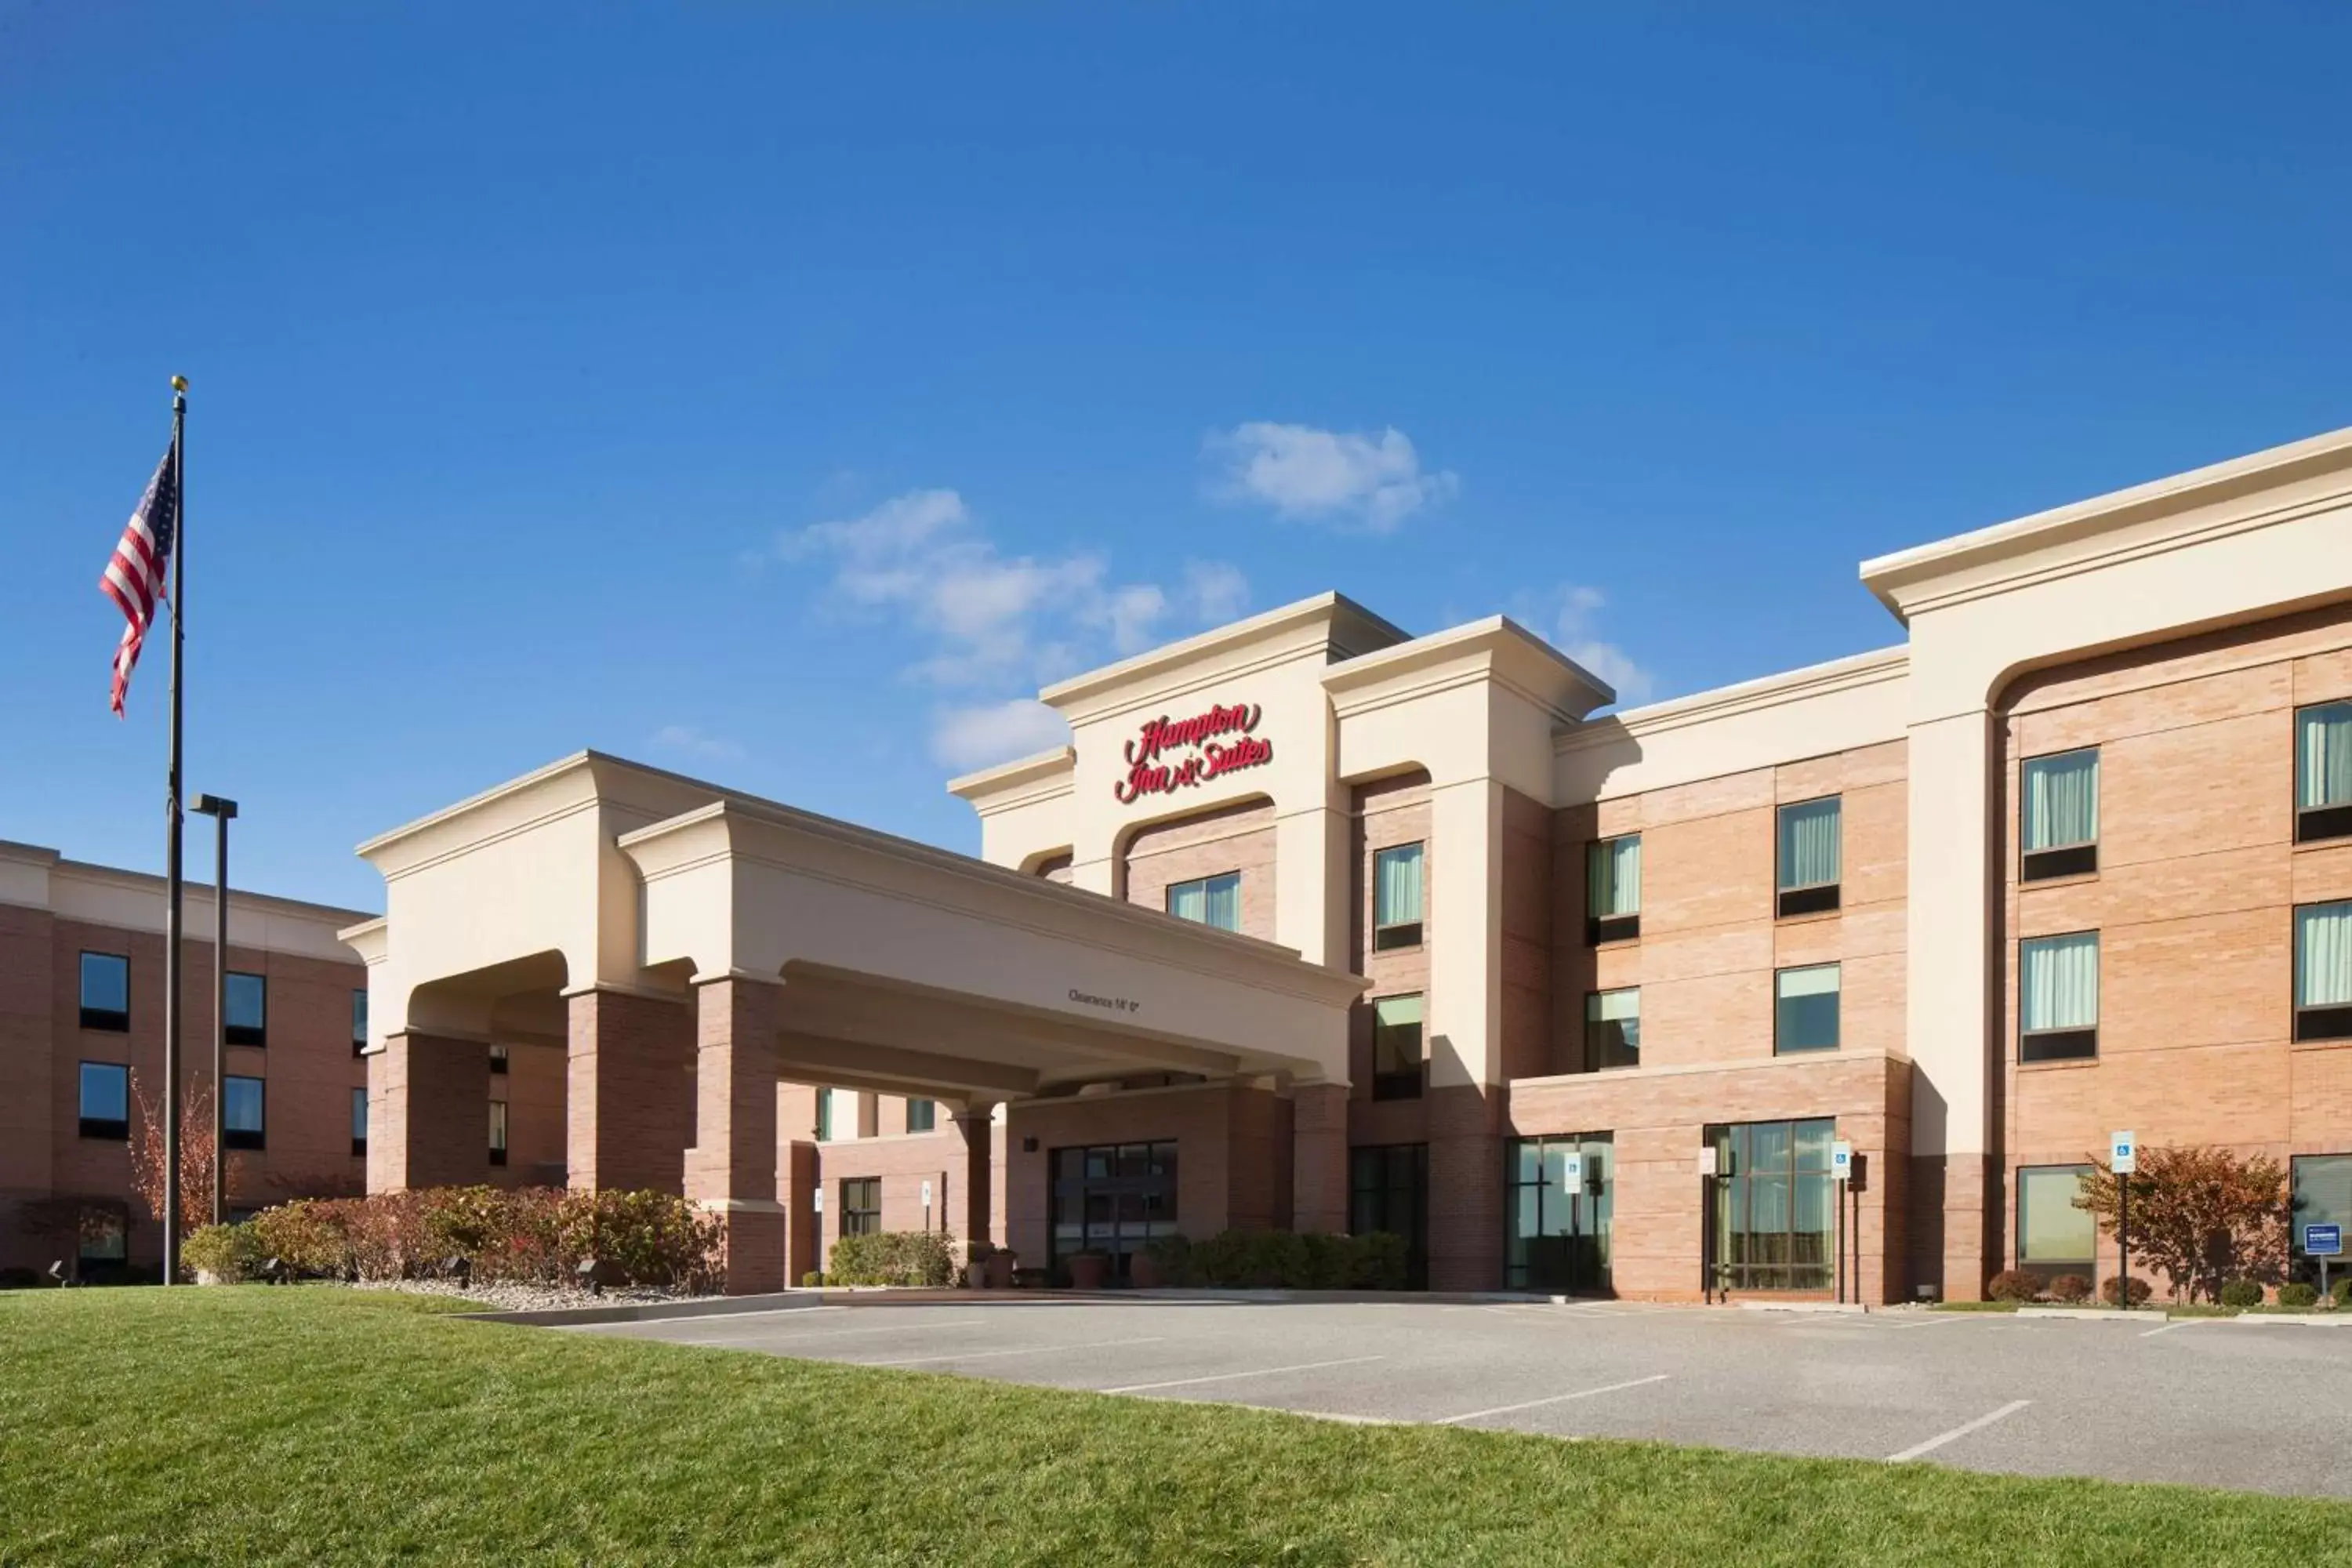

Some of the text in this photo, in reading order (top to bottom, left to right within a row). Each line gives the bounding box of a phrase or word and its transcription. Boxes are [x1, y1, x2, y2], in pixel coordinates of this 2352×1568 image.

[1124, 703, 1261, 765] Hampton
[1115, 762, 1178, 804] Inn
[1195, 735, 1273, 781] Suites
[1069, 989, 1112, 1008] Clearance
